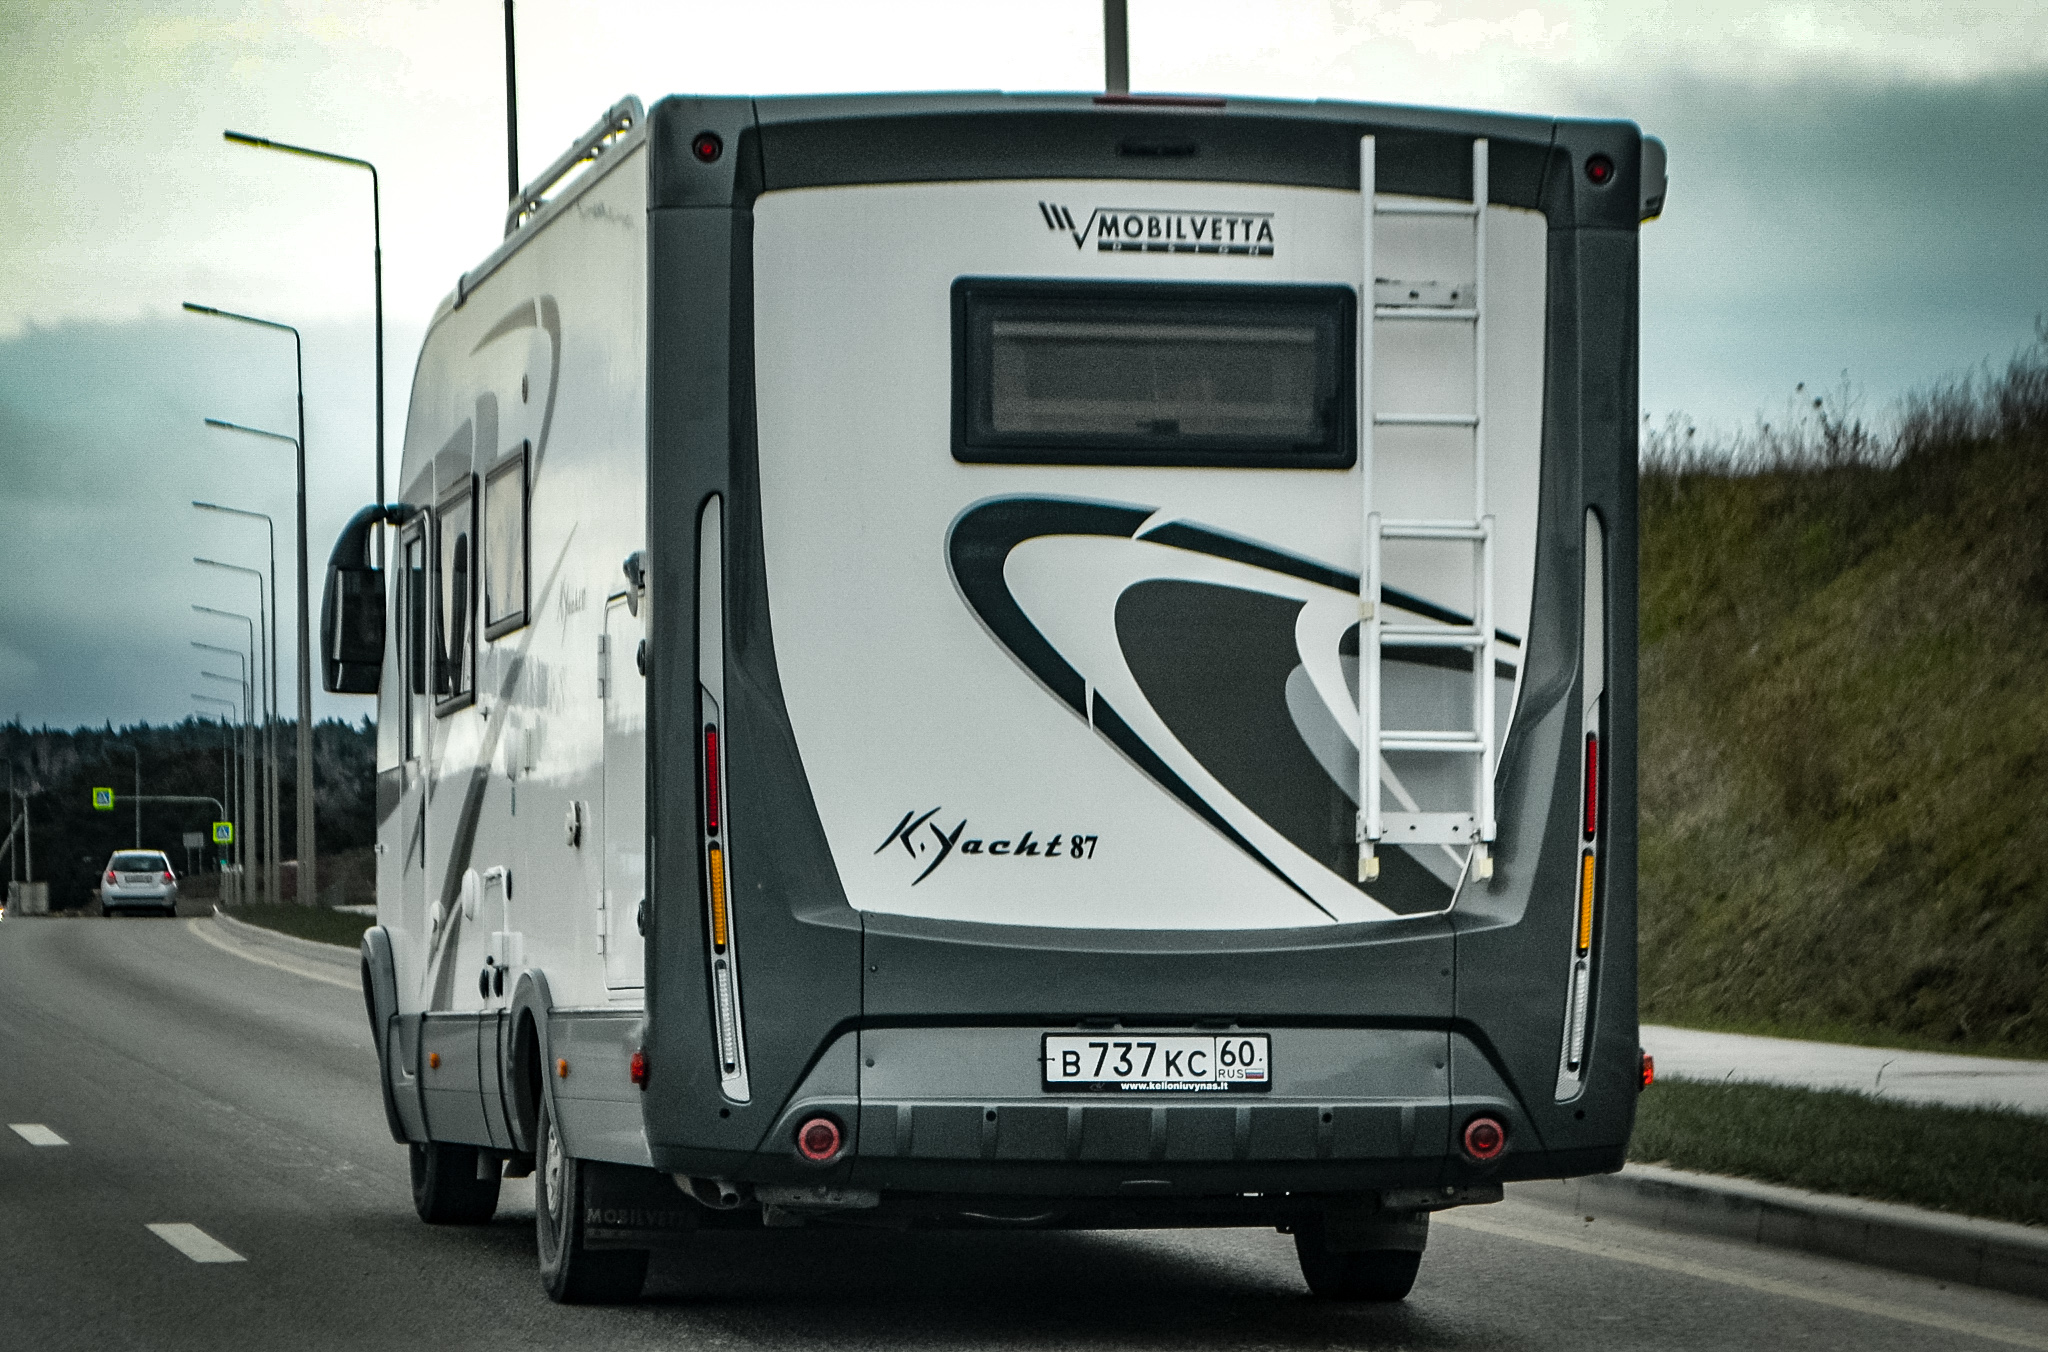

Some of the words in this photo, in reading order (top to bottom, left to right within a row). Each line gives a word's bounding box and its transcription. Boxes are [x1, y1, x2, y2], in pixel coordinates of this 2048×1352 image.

[1098, 214, 1275, 243] MOBILVETTA
[1070, 834, 1099, 860] 87
[1220, 1040, 1255, 1067] 60
[1218, 1069, 1245, 1079] RUS
